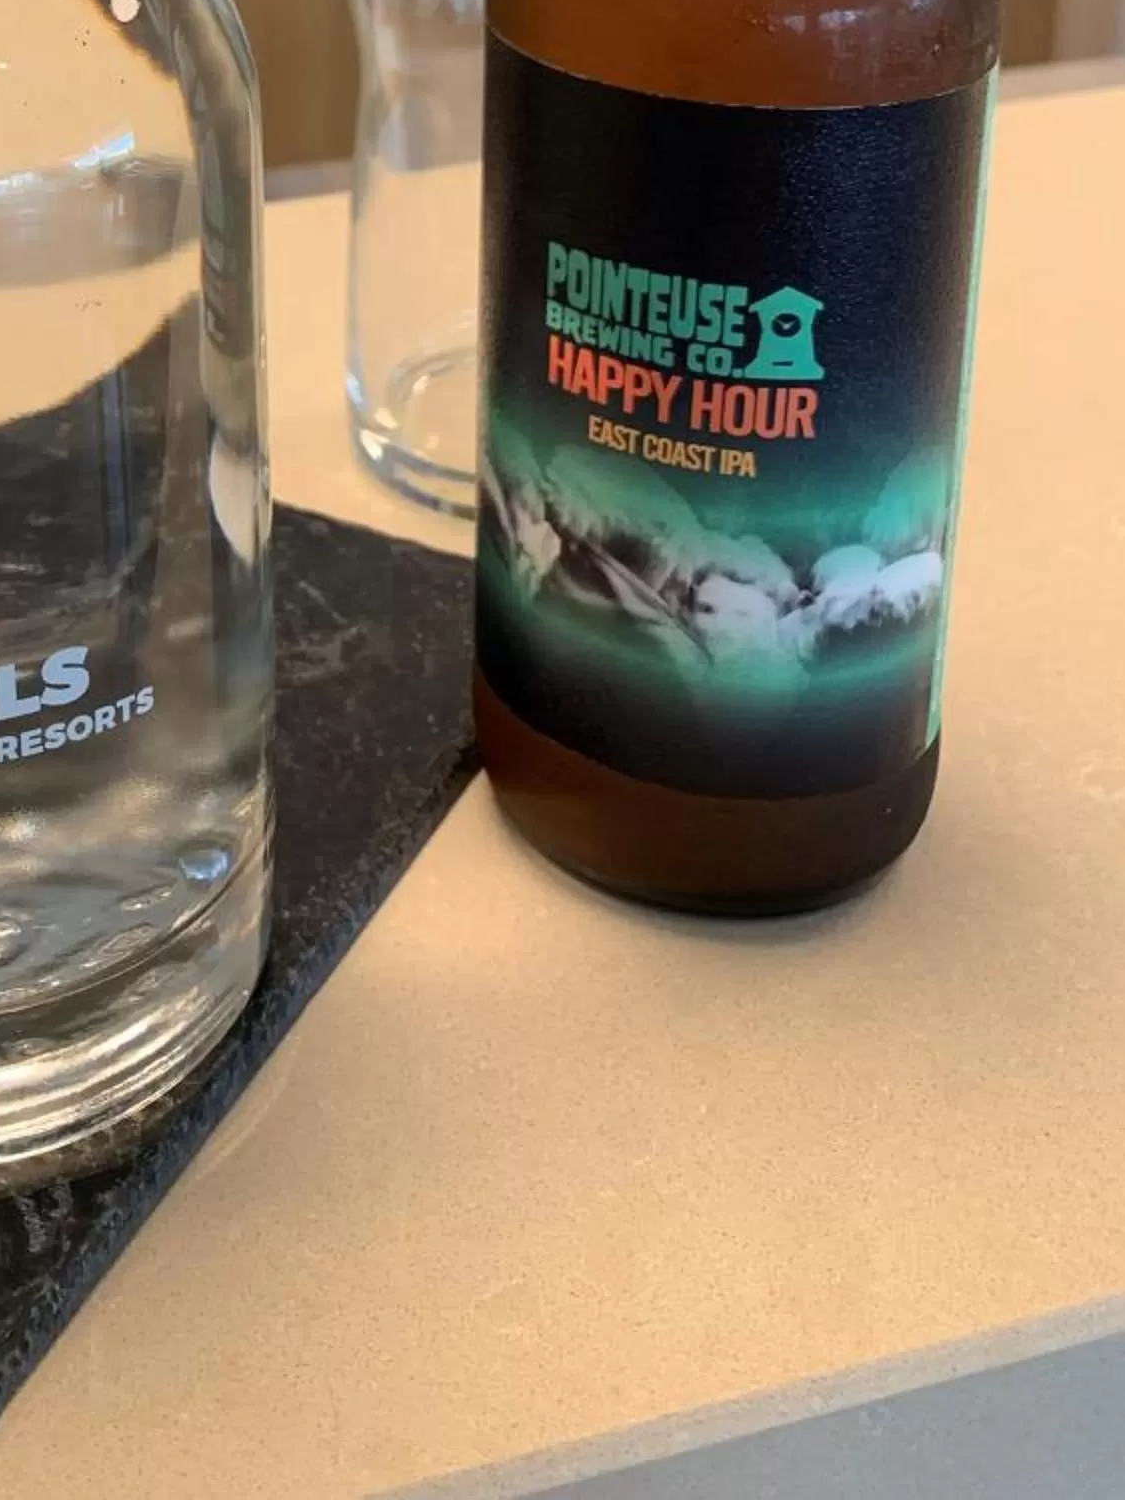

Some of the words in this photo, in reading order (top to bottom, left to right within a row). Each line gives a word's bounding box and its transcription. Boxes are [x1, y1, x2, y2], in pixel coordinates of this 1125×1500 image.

[545, 300, 675, 367] BREWING
[686, 343, 743, 378] CO.
[546, 240, 748, 347] POINTEUSE
[547, 333, 683, 423] HAPPY
[689, 378, 818, 439] HOUR
[588, 414, 642, 455] EAST
[642, 432, 716, 473] COAST
[719, 448, 756, 478] IPA
